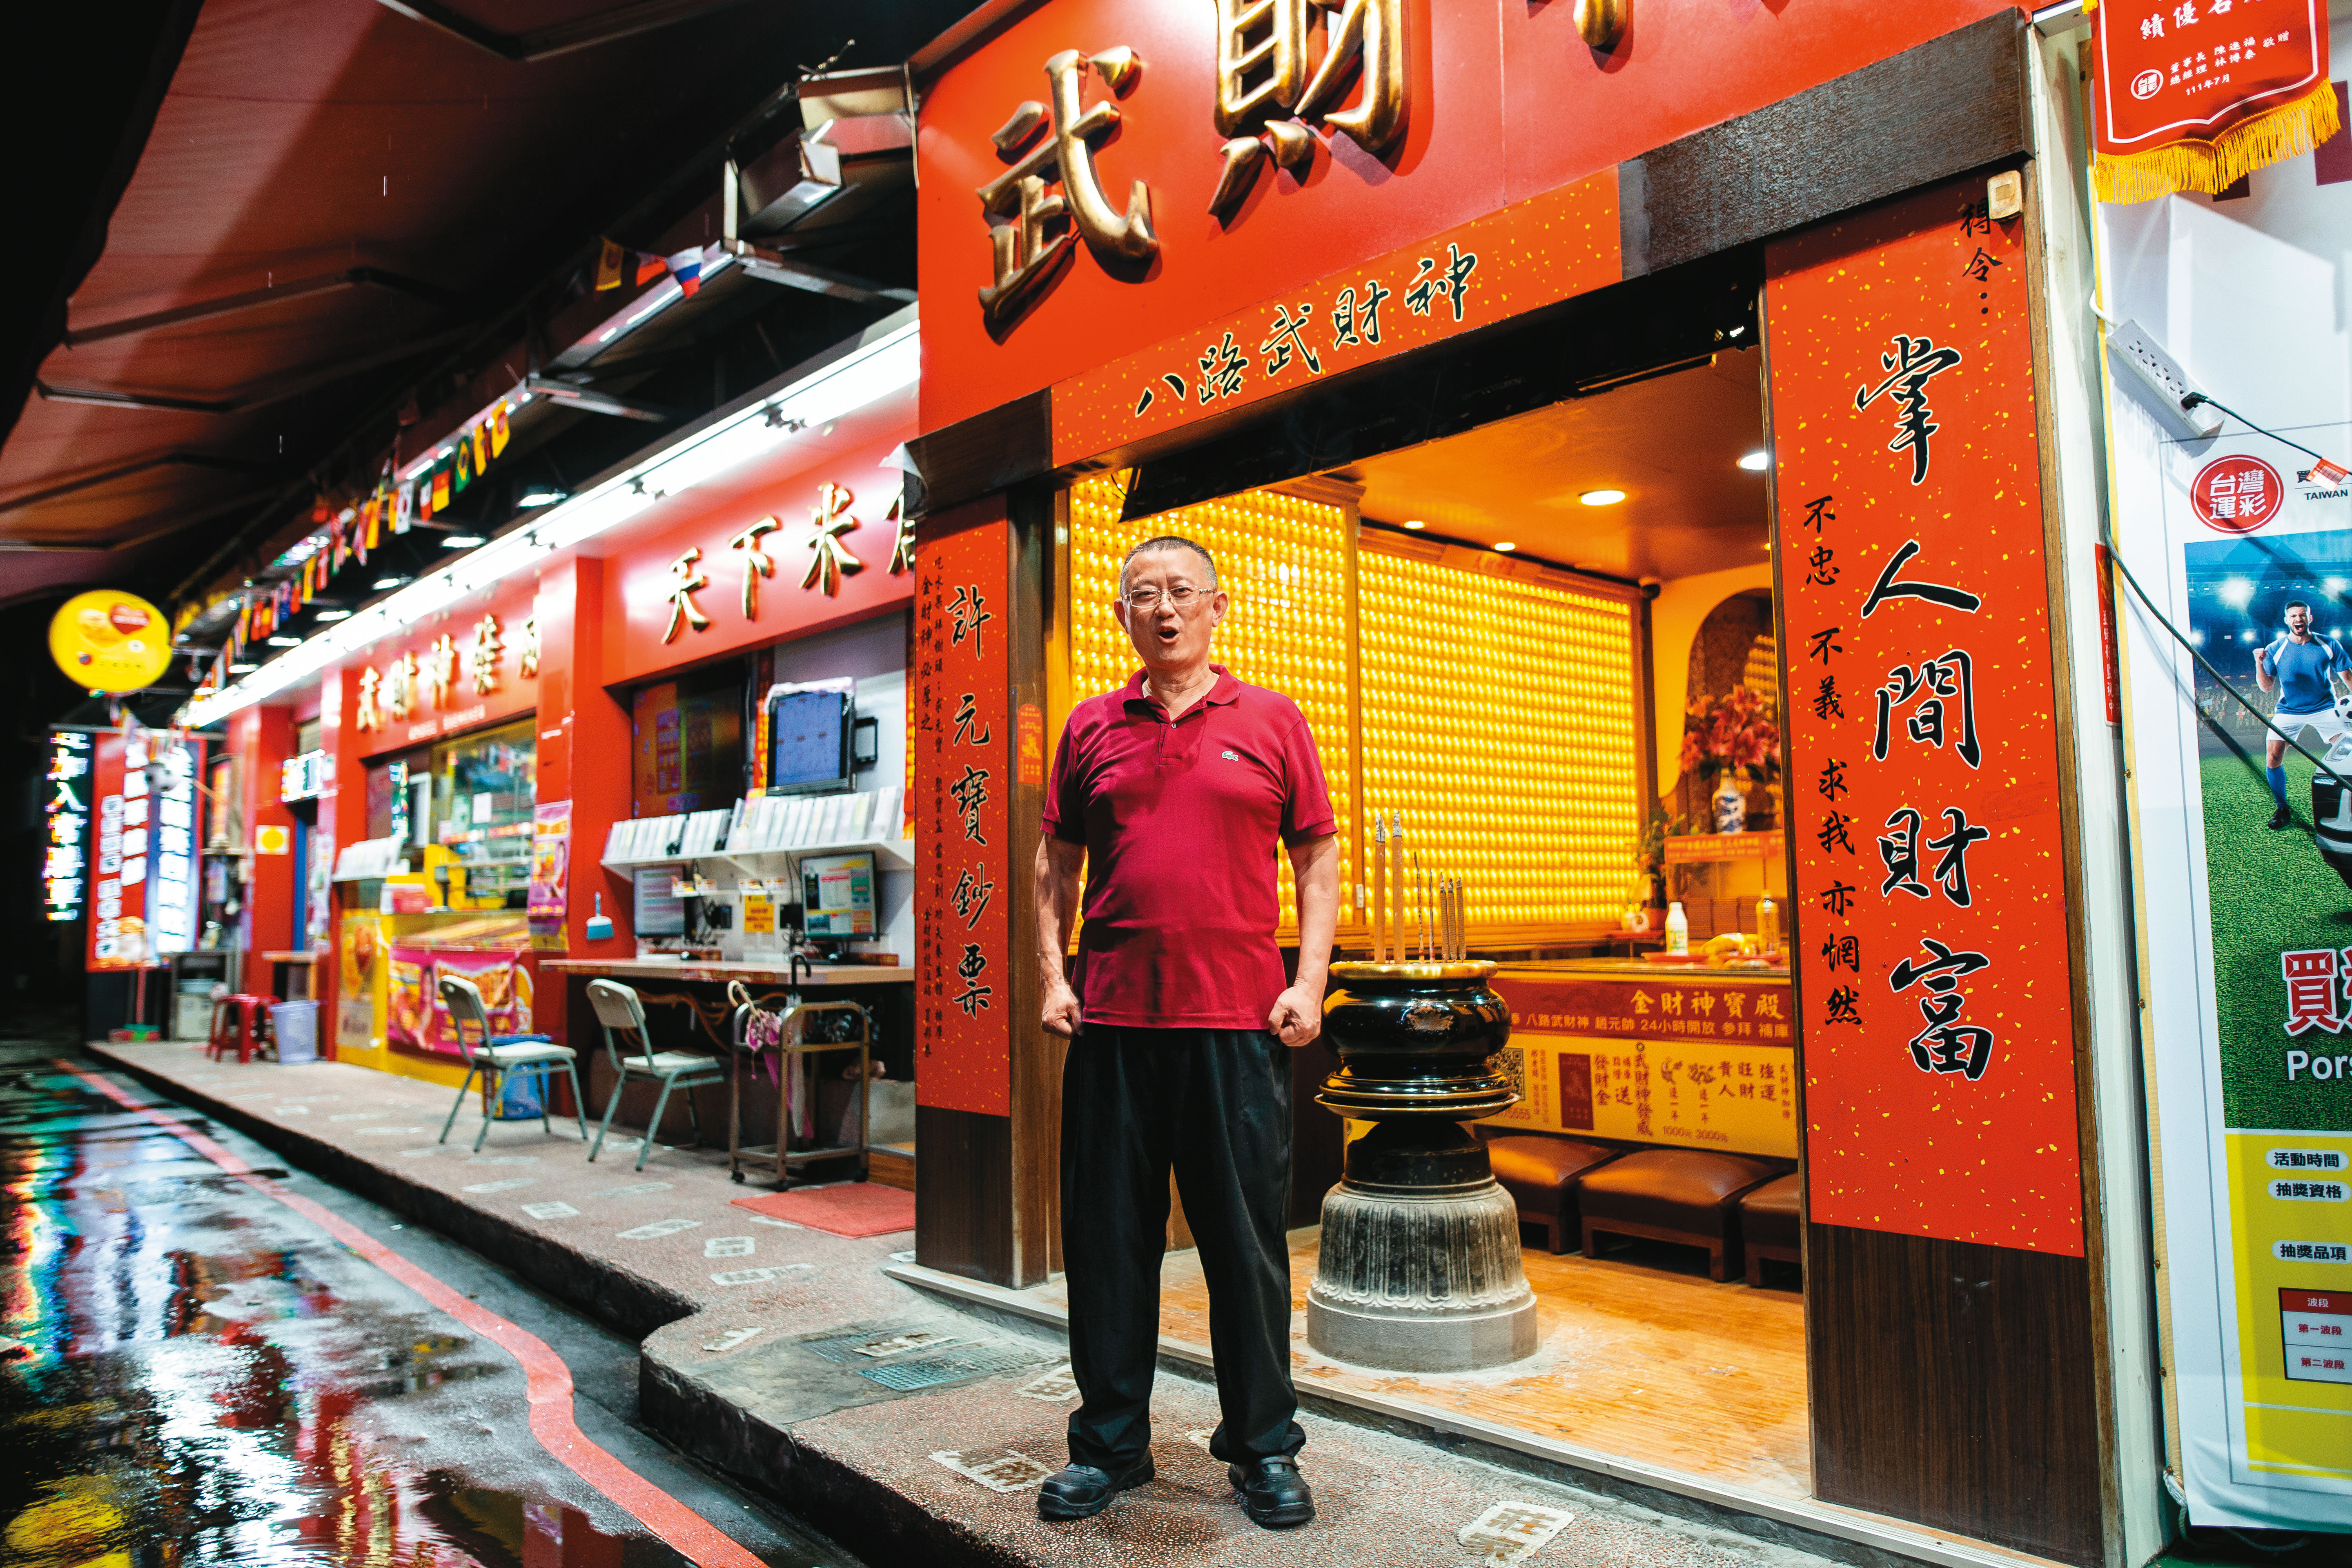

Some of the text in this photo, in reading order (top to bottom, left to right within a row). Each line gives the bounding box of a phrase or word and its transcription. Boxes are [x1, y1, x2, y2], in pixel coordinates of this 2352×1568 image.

[2169, 51, 2207, 74] 董事長
[2263, 31, 2290, 48] 敬贈
[2169, 64, 2207, 86] 總經理
[2185, 74, 2230, 96] 111年7月
[977, 0, 1627, 319] 武財
[1135, 243, 1478, 418] 八路武財神
[2210, 469, 2265, 497] 台灣
[2303, 489, 2348, 500] TAIWAN
[2209, 492, 2267, 520] 運彩
[1855, 334, 1994, 1081] 掌人間財富
[1630, 989, 1784, 1020] 金財神寶殿
[1526, 1013, 1589, 1029] 八路武財神
[1641, 1019, 1715, 1036] 24小時開放
[2287, 1050, 2352, 1080] Por
[2274, 1152, 2340, 1168] 活動時間
[2276, 1183, 2342, 1199] 抽獎資格
[2280, 1243, 2346, 1260] 抽獎品項
[2307, 1298, 2329, 1308] 波段
[2298, 1323, 2342, 1336] 第一波段
[2301, 1357, 2345, 1370] 第二波段
